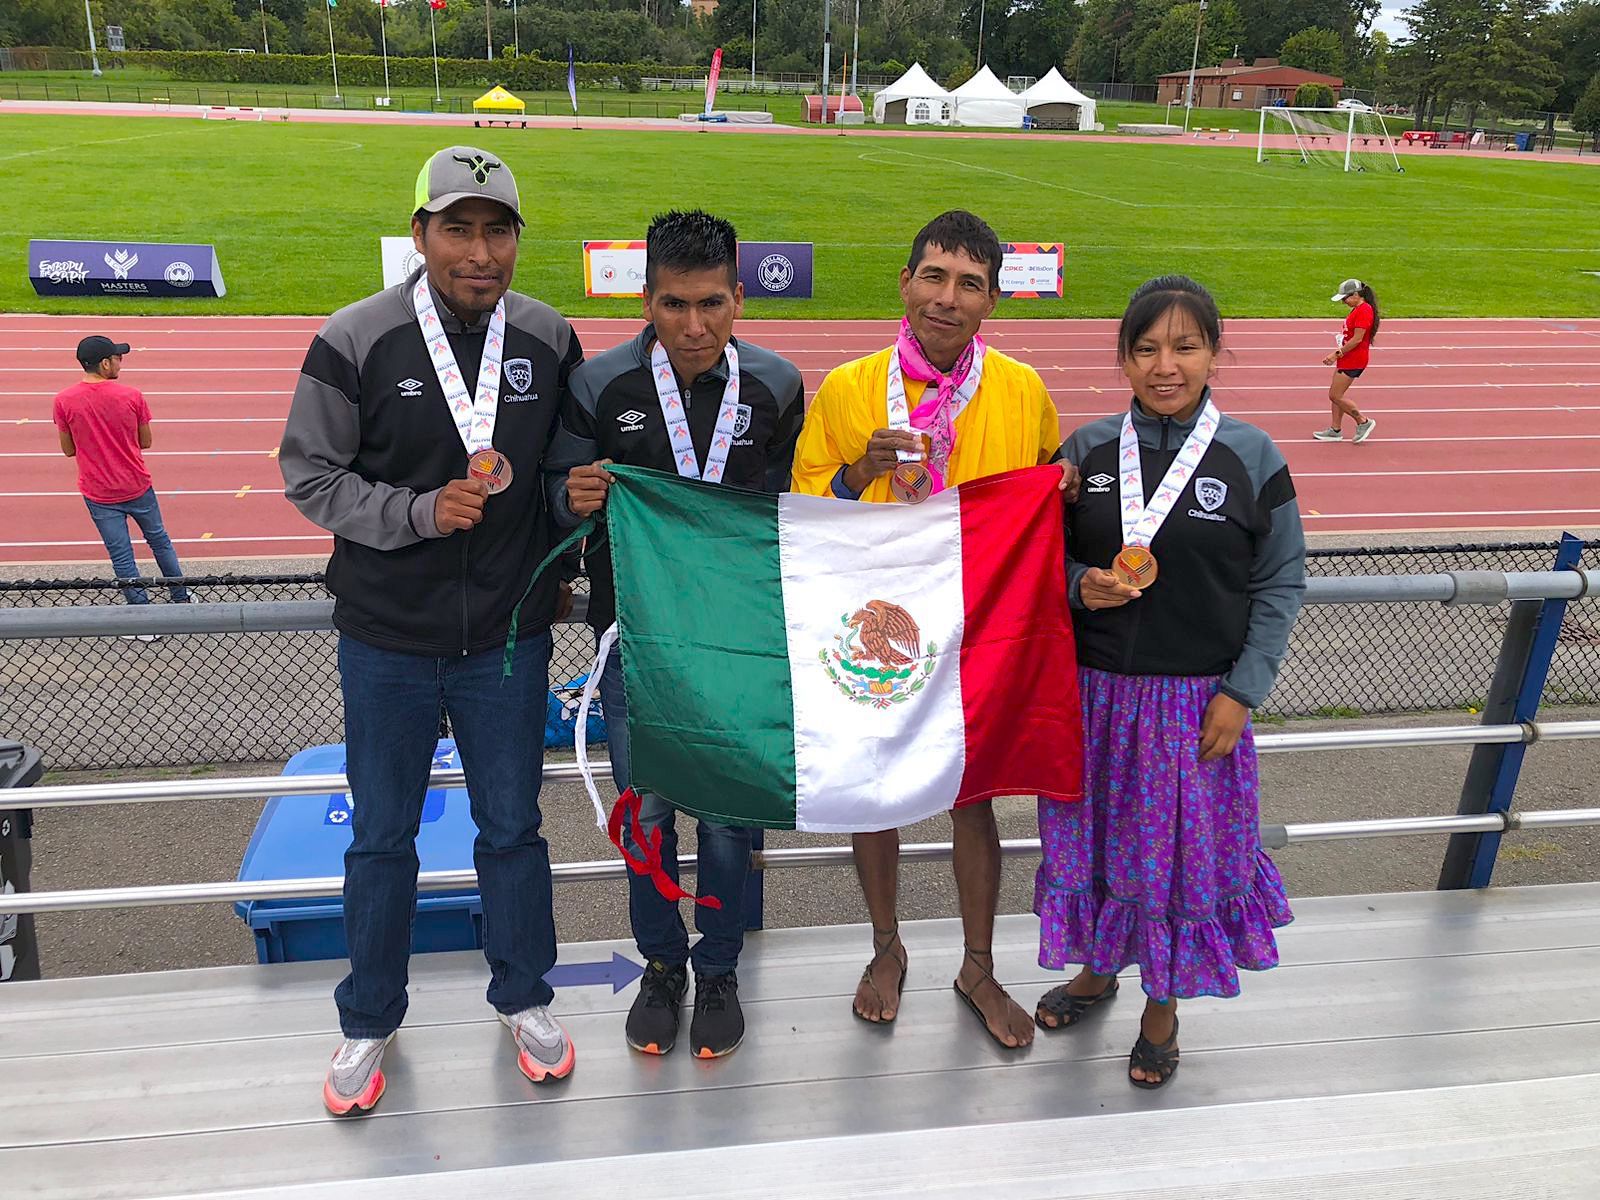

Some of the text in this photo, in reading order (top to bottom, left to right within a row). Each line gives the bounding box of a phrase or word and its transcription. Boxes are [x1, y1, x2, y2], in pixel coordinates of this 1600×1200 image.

[39, 260, 84, 272] EMBODY
[762, 257, 789, 267] WELLNESS
[50, 270, 90, 284] SPIRIT
[764, 280, 788, 289] WARRIOR
[448, 391, 467, 400] MASTERS
[504, 394, 538, 402] Chihuahua
[620, 424, 644, 432] umbro
[1188, 509, 1226, 521] Chihuahua
